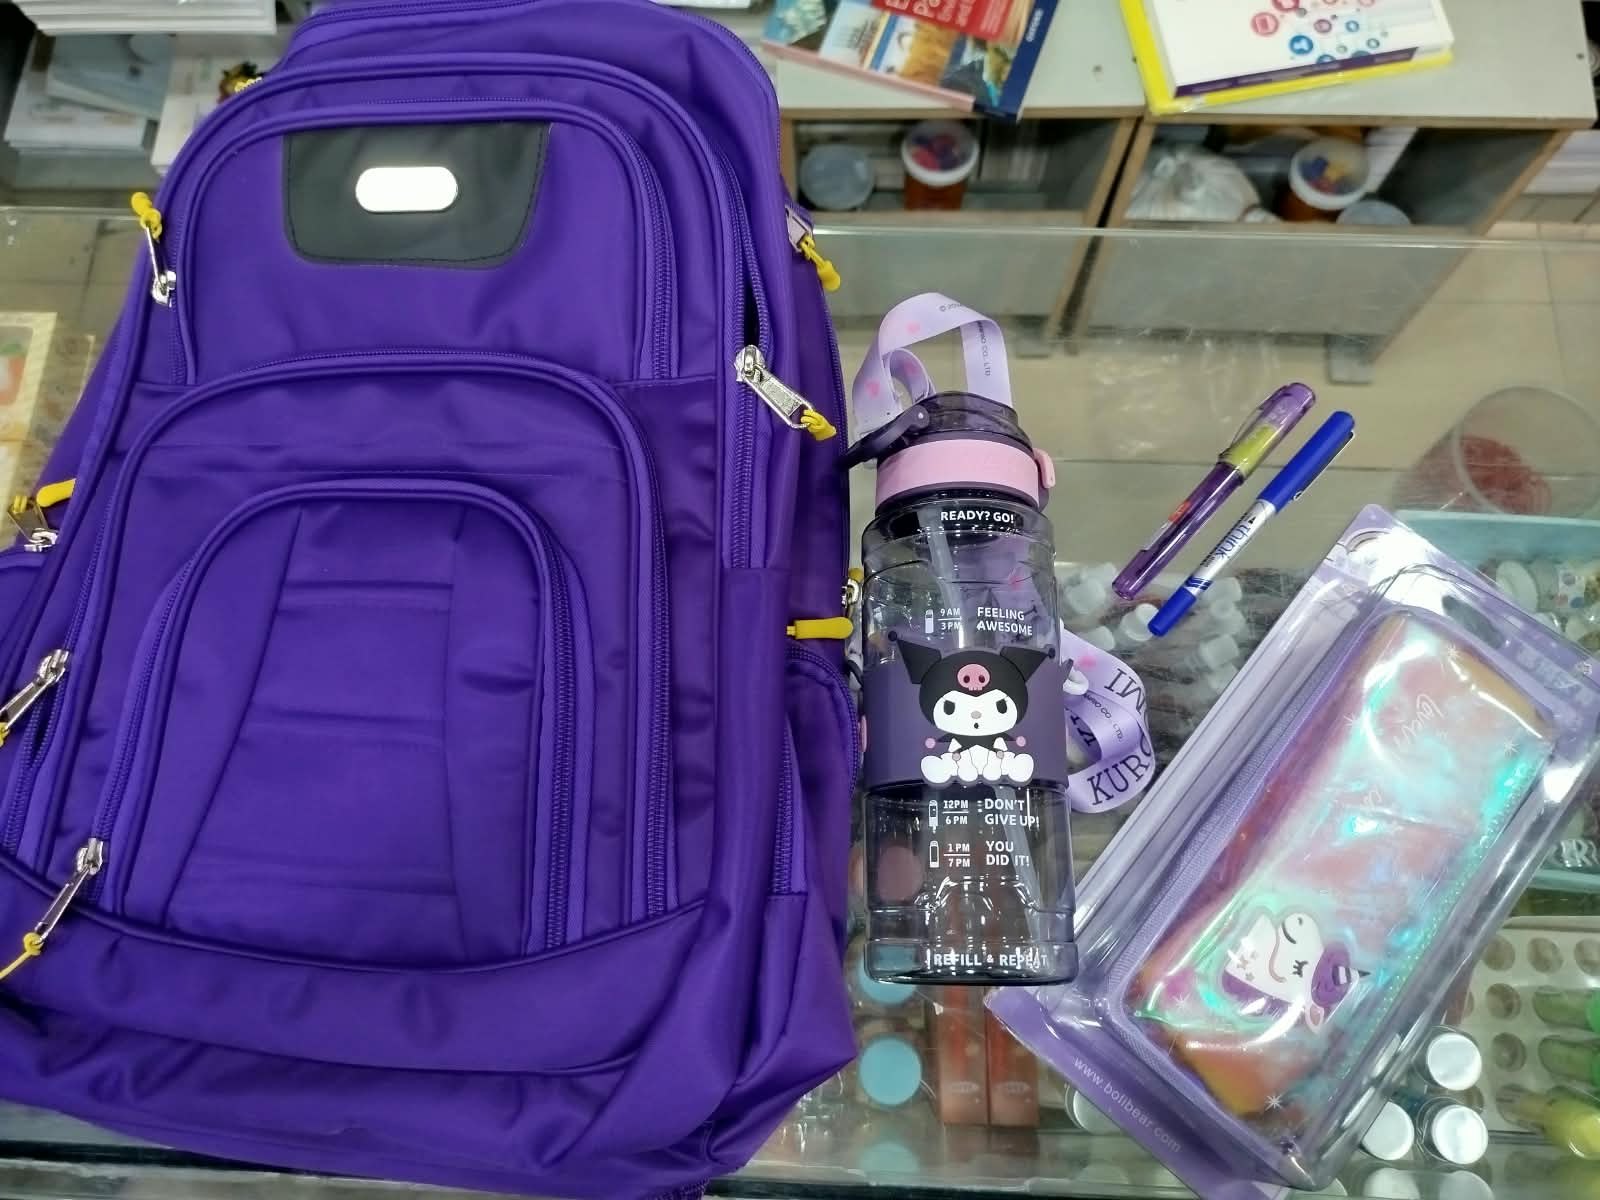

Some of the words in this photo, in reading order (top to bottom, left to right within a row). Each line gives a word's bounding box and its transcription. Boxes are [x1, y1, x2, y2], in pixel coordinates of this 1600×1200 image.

[940, 510, 991, 521] READY?
[993, 511, 1015, 523] GO!
[940, 608, 946, 617] 9
[977, 606, 1025, 621] FEELING
[940, 622, 947, 631] 3
[976, 620, 1033, 636] AWESOME
[984, 798, 1025, 811] DON'T
[945, 816, 951, 825] 6
[953, 816, 968, 825] PM
[984, 814, 1017, 826] GIVE
[1019, 815, 1040, 828] UP!
[955, 843, 970, 852] PM
[985, 840, 1014, 852] YOU
[948, 858, 954, 867] 7
[956, 858, 971, 868] PM
[986, 854, 1010, 866] DID
[1014, 855, 1030, 867] IT!
[933, 953, 982, 966] REFILL
[986, 954, 994, 964] &
[1000, 954, 1048, 967] REPEAT
